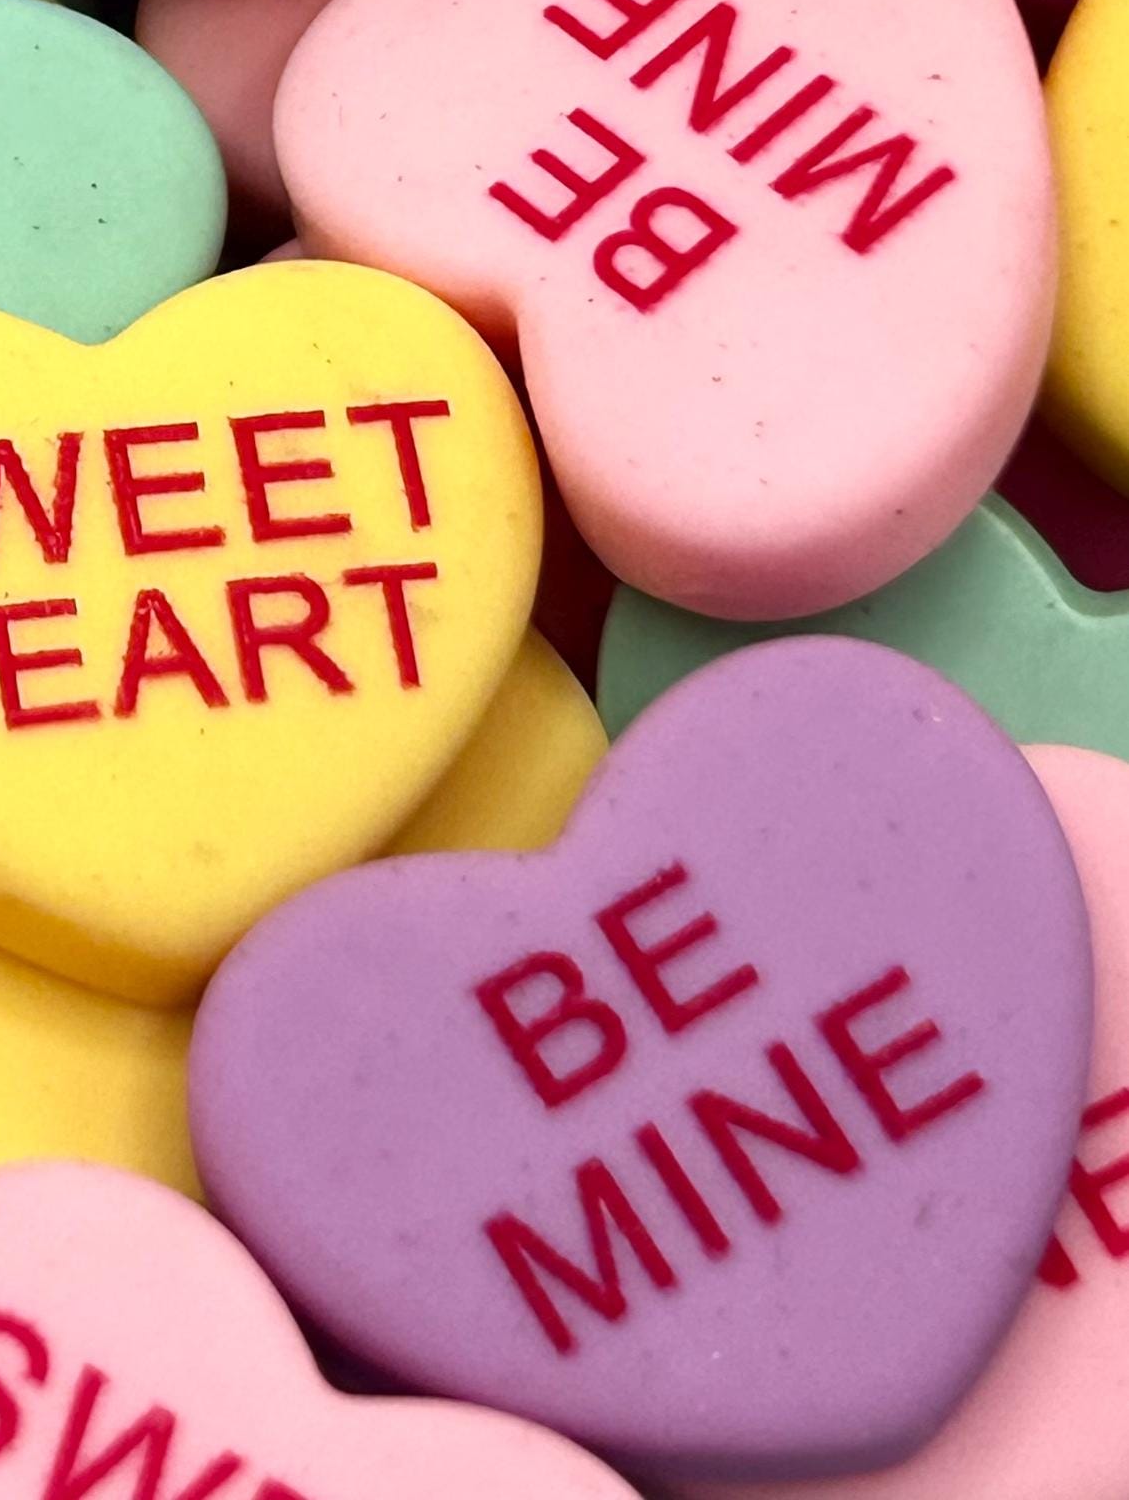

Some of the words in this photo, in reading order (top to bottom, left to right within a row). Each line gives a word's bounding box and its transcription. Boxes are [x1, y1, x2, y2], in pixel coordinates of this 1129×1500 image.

[489, 107, 739, 313] BE
[474, 859, 759, 1109] BE
[482, 964, 987, 1357] MINE
